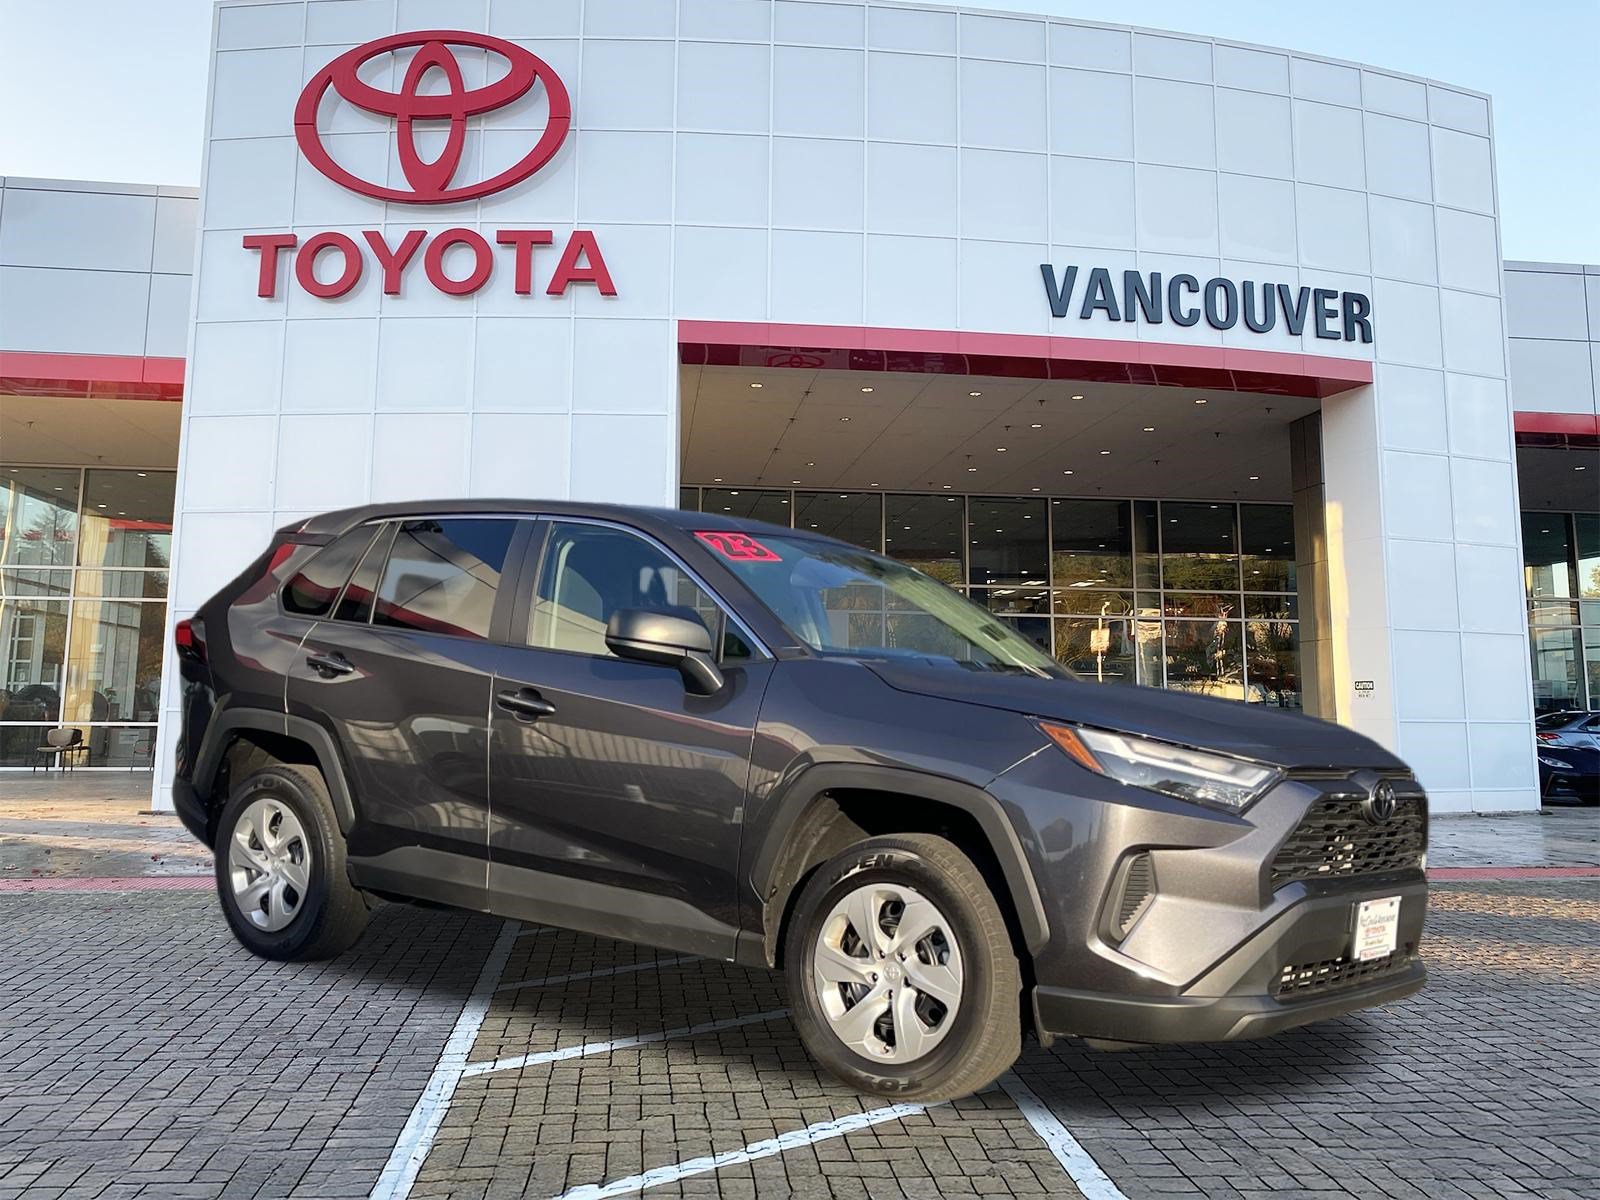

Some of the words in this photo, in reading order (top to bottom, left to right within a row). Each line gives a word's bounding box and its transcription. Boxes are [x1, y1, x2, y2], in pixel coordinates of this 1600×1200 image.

[243, 228, 617, 299] TOYOTA
[1040, 264, 1373, 343] VANCOUVER
[703, 533, 769, 557] 23
